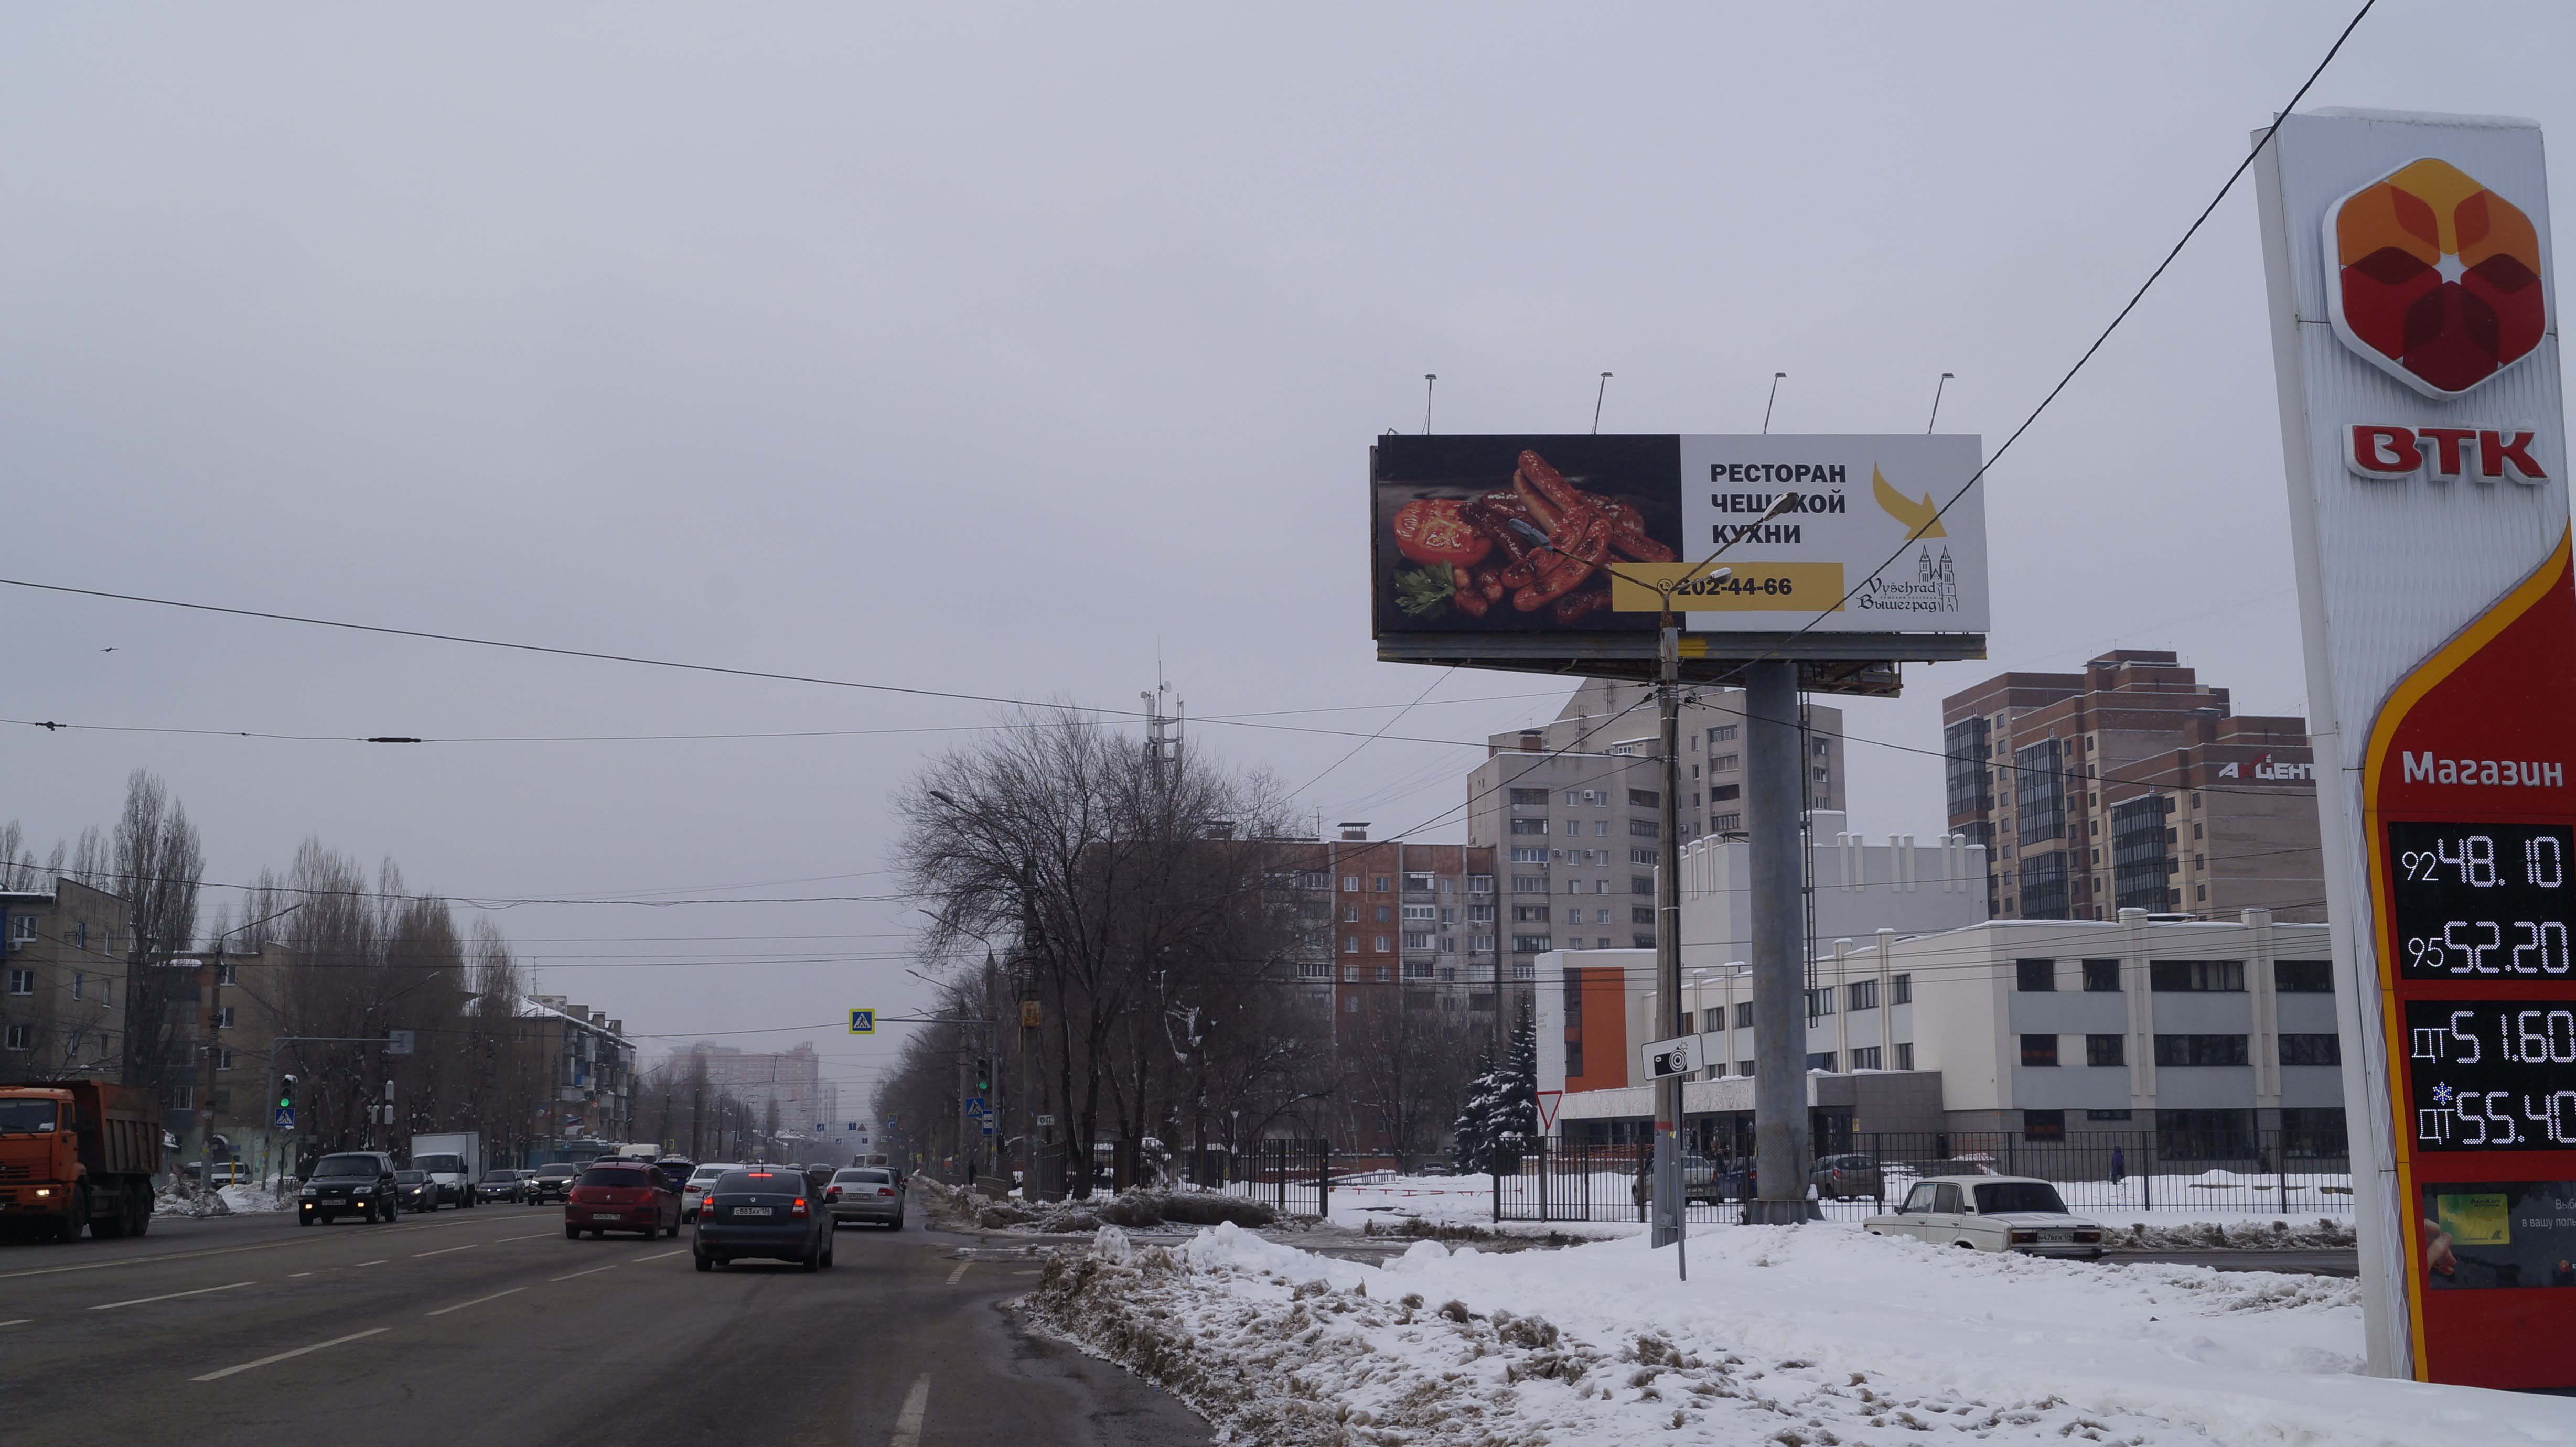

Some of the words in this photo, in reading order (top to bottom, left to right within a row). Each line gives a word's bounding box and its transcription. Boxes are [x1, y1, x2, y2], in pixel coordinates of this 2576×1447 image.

[2352, 425, 2548, 478] ВТК
[1710, 463, 1846, 483] РЕСТОРАН
[1711, 489, 1845, 513] ЧЕШКОЙ
[1712, 524, 1801, 544] КУХНИ
[1677, 577, 1793, 596] 202-44-66
[1868, 577, 1936, 596] Vyšehrad
[1856, 593, 1937, 613] Вышеград
[2402, 751, 2563, 787] Магазин
[2402, 851, 2439, 881] 92
[2438, 836, 2563, 888] 48.10
[2408, 937, 2444, 967] 95
[2444, 921, 2570, 974] 52.20
[2411, 1028, 2450, 1064] ДТ
[2451, 1010, 2576, 1063] 51.60
[2419, 1109, 2455, 1145] ДТ
[2555, 1198, 2576, 1210] Выб
[2522, 1219, 2528, 1227] в
[2530, 1218, 2553, 1229] вашу
